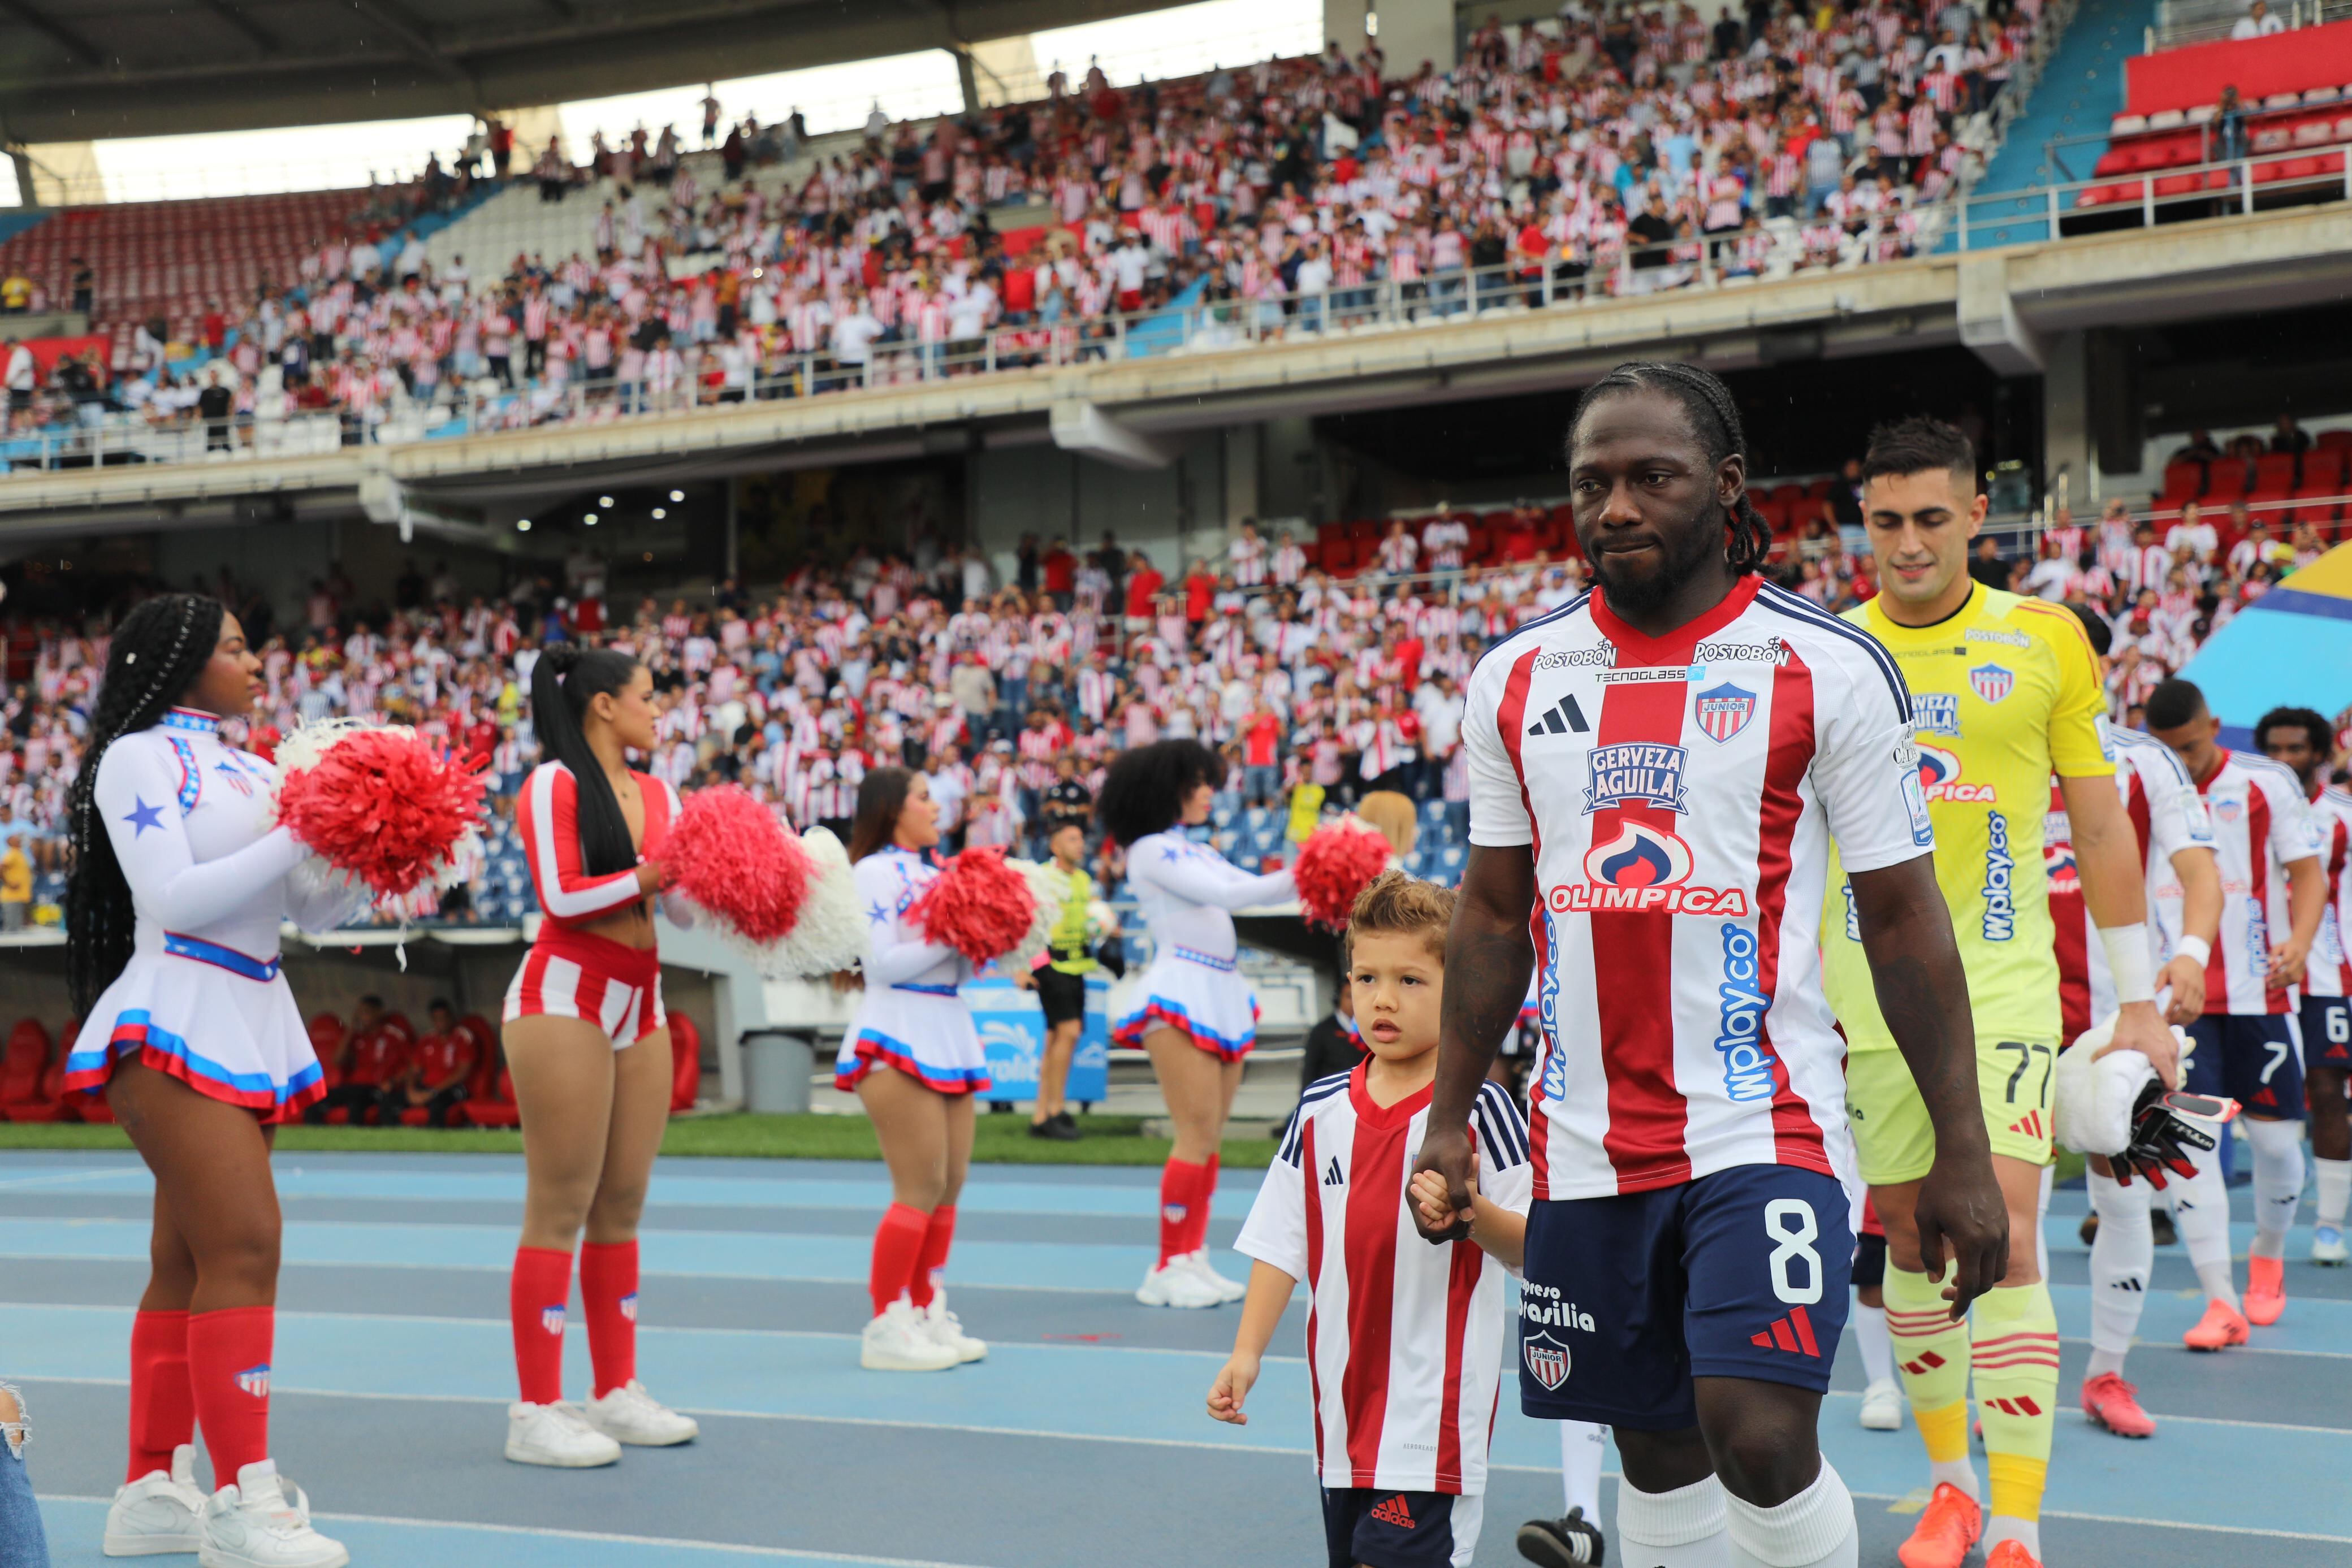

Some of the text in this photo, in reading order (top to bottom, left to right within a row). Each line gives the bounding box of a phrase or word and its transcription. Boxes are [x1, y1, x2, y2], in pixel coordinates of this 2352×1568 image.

[1704, 703, 1746, 712] JUNIOR
[1914, 710, 1953, 729] UILA
[1594, 769, 1675, 800] AGUILA
[1925, 784, 1996, 802] PICA
[1551, 886, 1745, 915] OLIMPICA
[2325, 1006, 2349, 1043] 6
[1995, 1041, 2051, 1108] 77
[2260, 1041, 2288, 1085] 7
[1764, 1198, 1823, 1305] 8
[1521, 1277, 1561, 1300] xpreso
[1532, 1352, 1562, 1362] JUNIOR
[1403, 1443, 1437, 1452] AEROREADY
[1371, 1508, 1416, 1529] adidas
